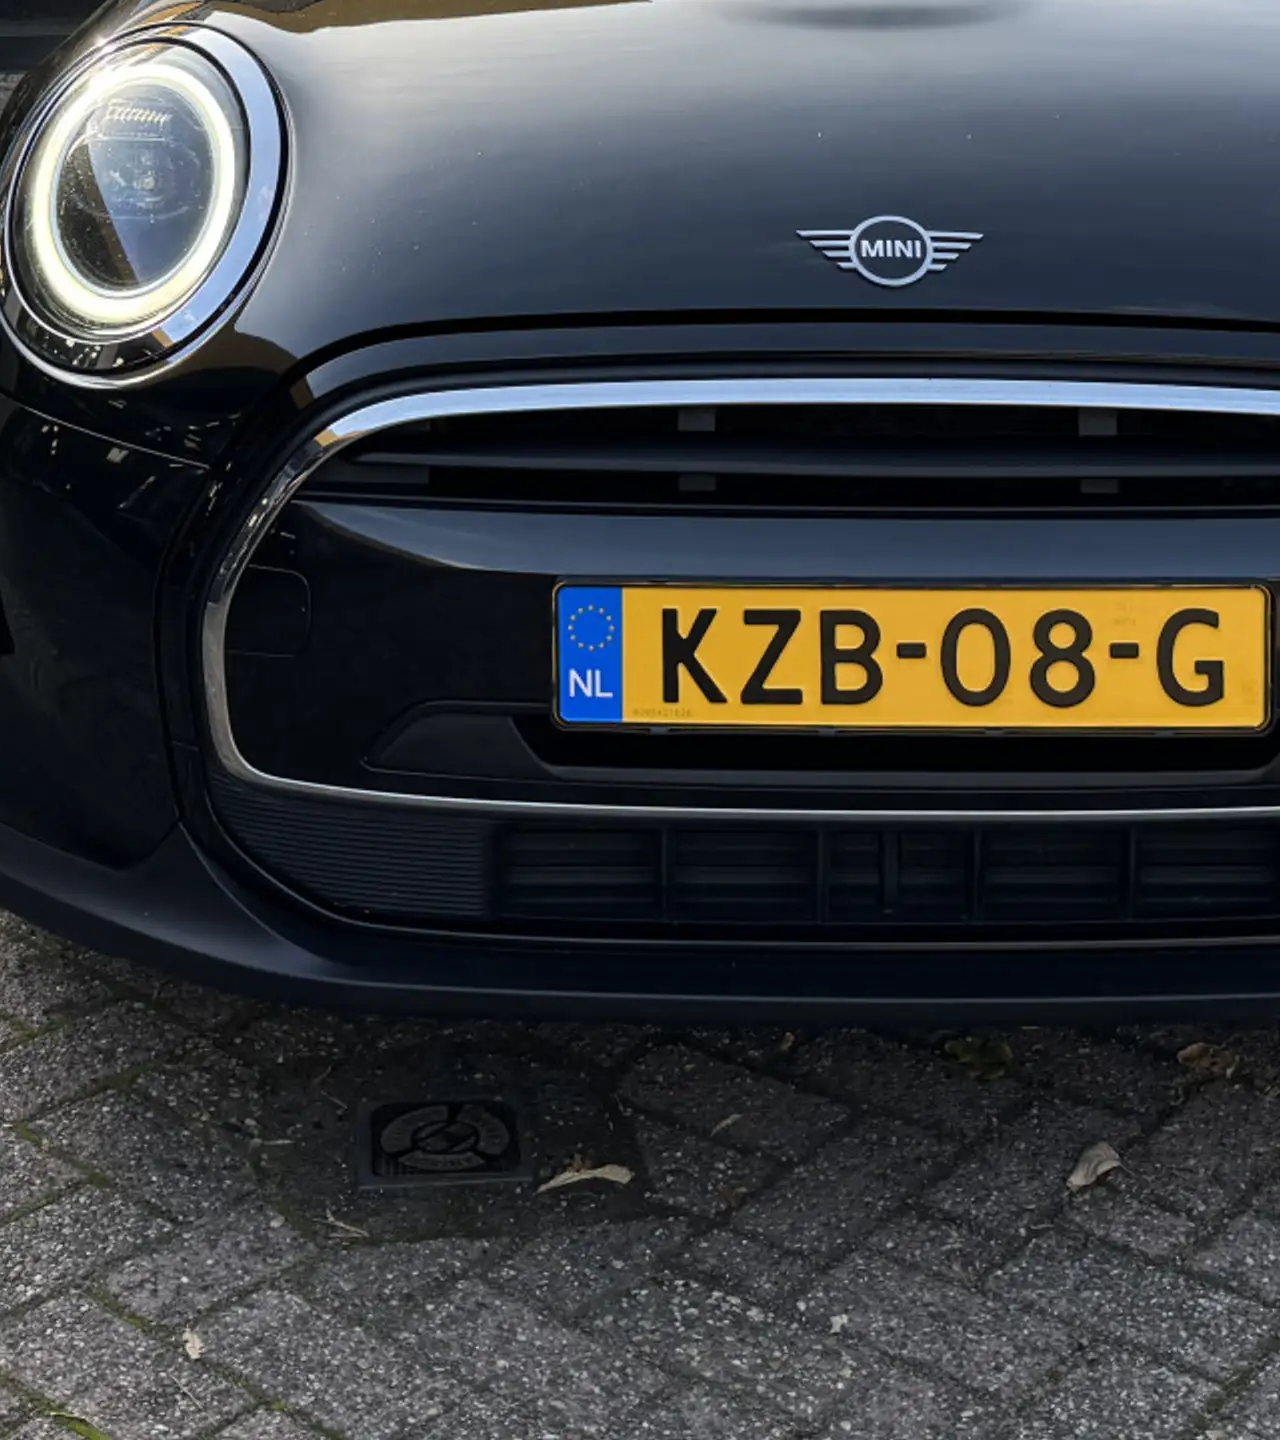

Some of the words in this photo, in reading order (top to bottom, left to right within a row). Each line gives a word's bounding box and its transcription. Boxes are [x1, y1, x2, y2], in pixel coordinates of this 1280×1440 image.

[860, 239, 921, 258] MINI
[568, 668, 614, 699] NL
[661, 607, 1225, 707] KZB-08-G
